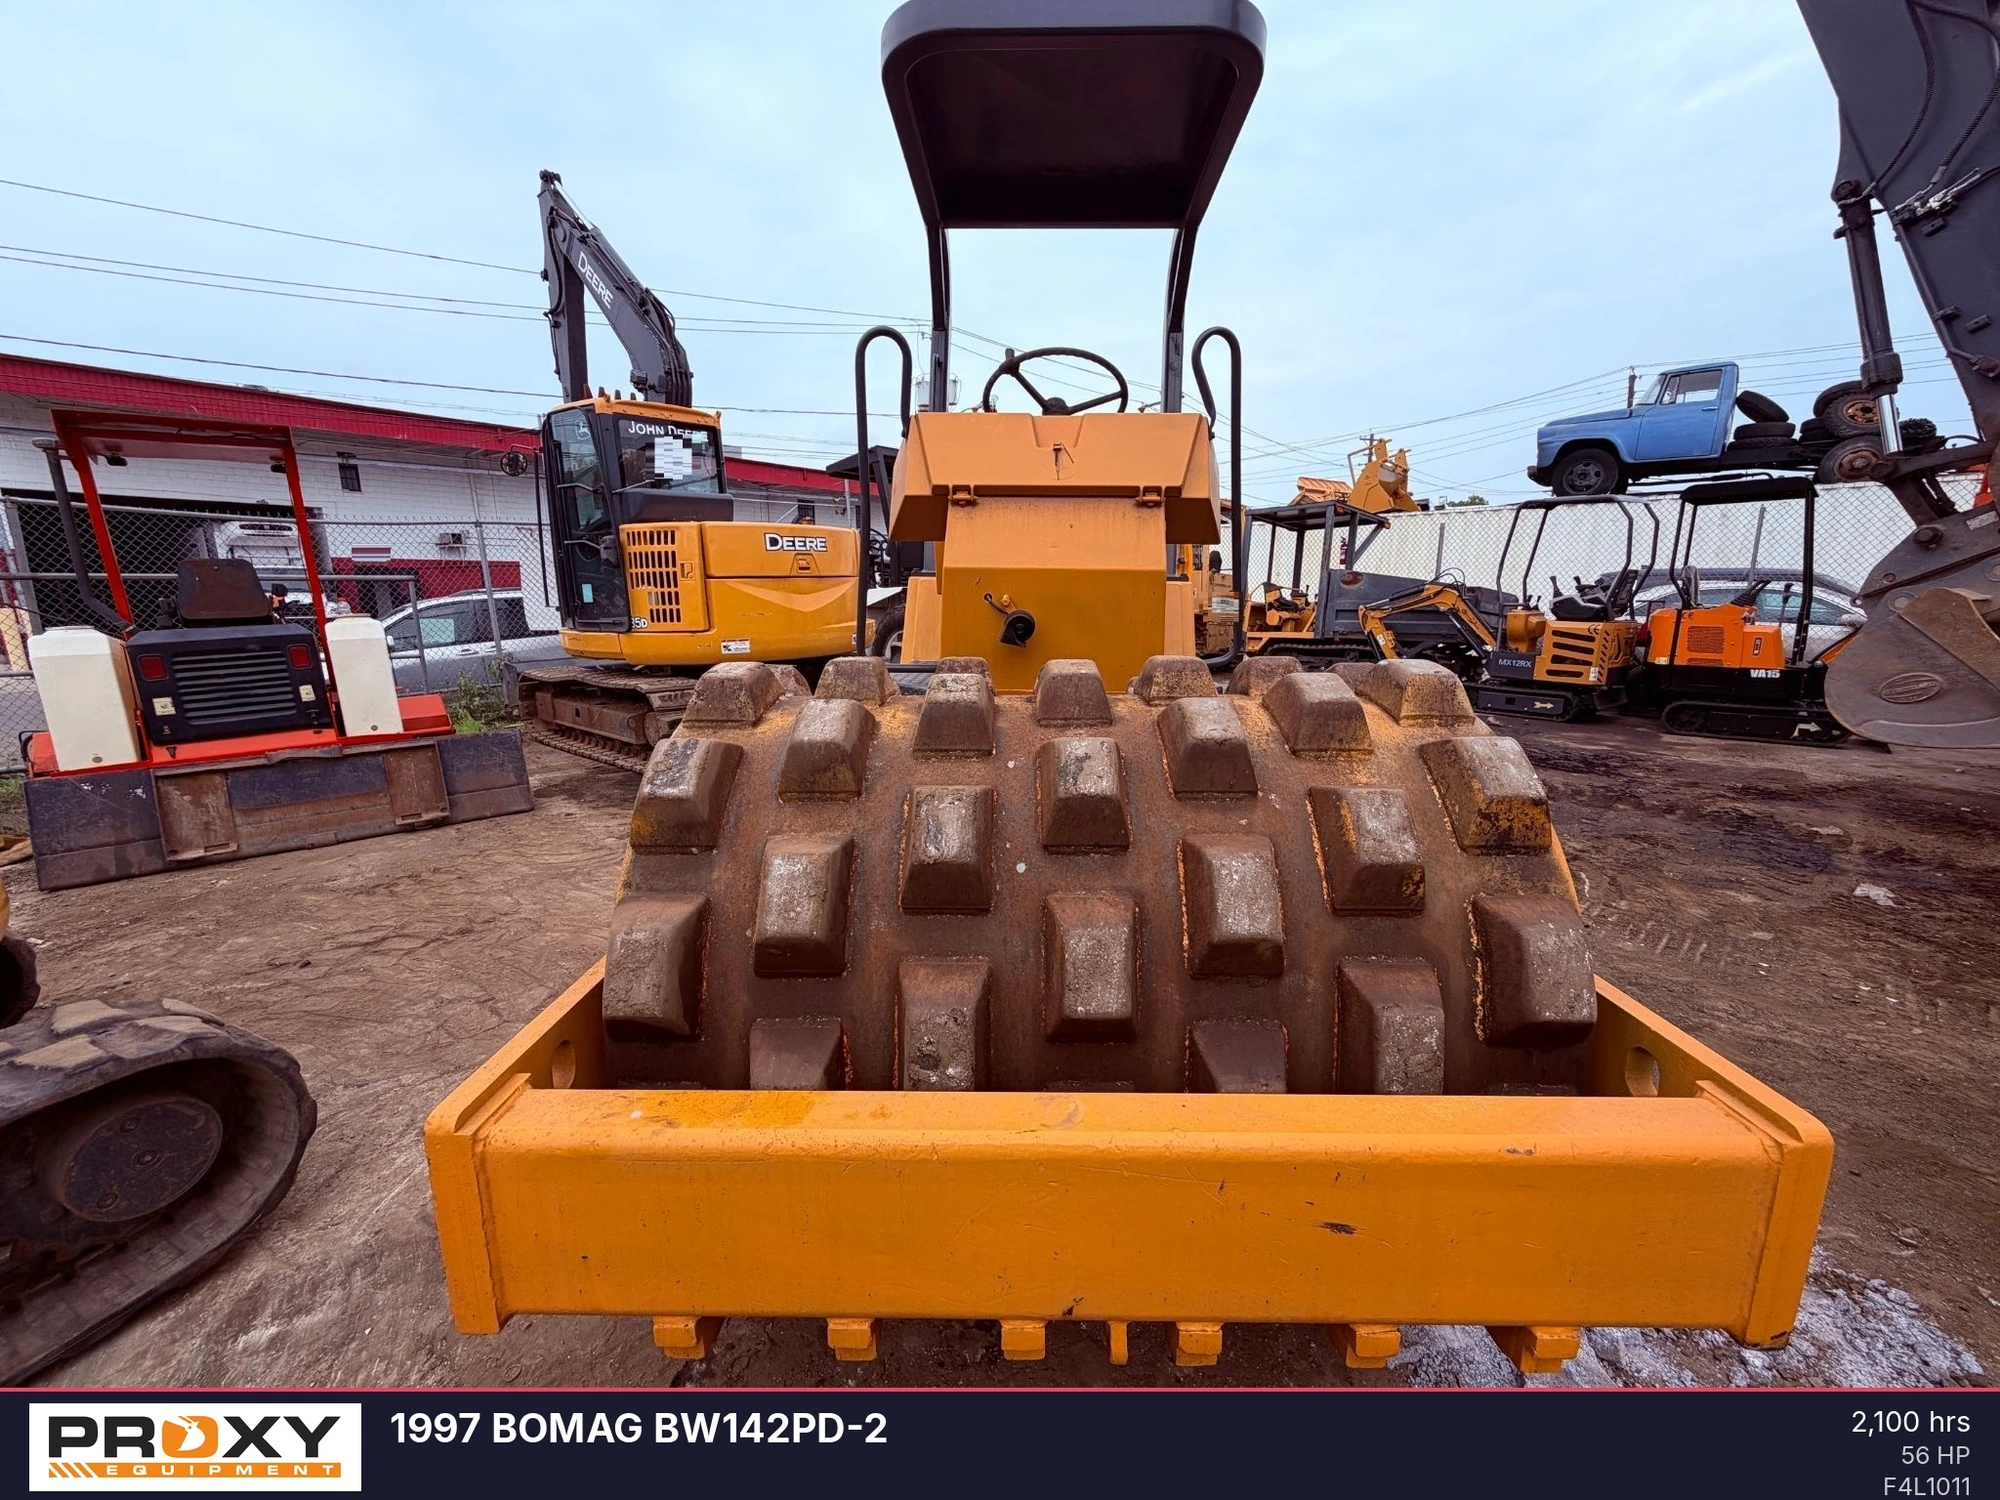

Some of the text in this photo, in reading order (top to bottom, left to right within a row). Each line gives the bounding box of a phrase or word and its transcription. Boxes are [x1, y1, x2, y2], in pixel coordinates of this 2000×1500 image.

[577, 250, 614, 310] DEERE
[628, 420, 665, 435] JOHN
[763, 532, 829, 552] DEERE
[1498, 658, 1532, 668] MX12RX
[1749, 669, 1780, 679] VA15
